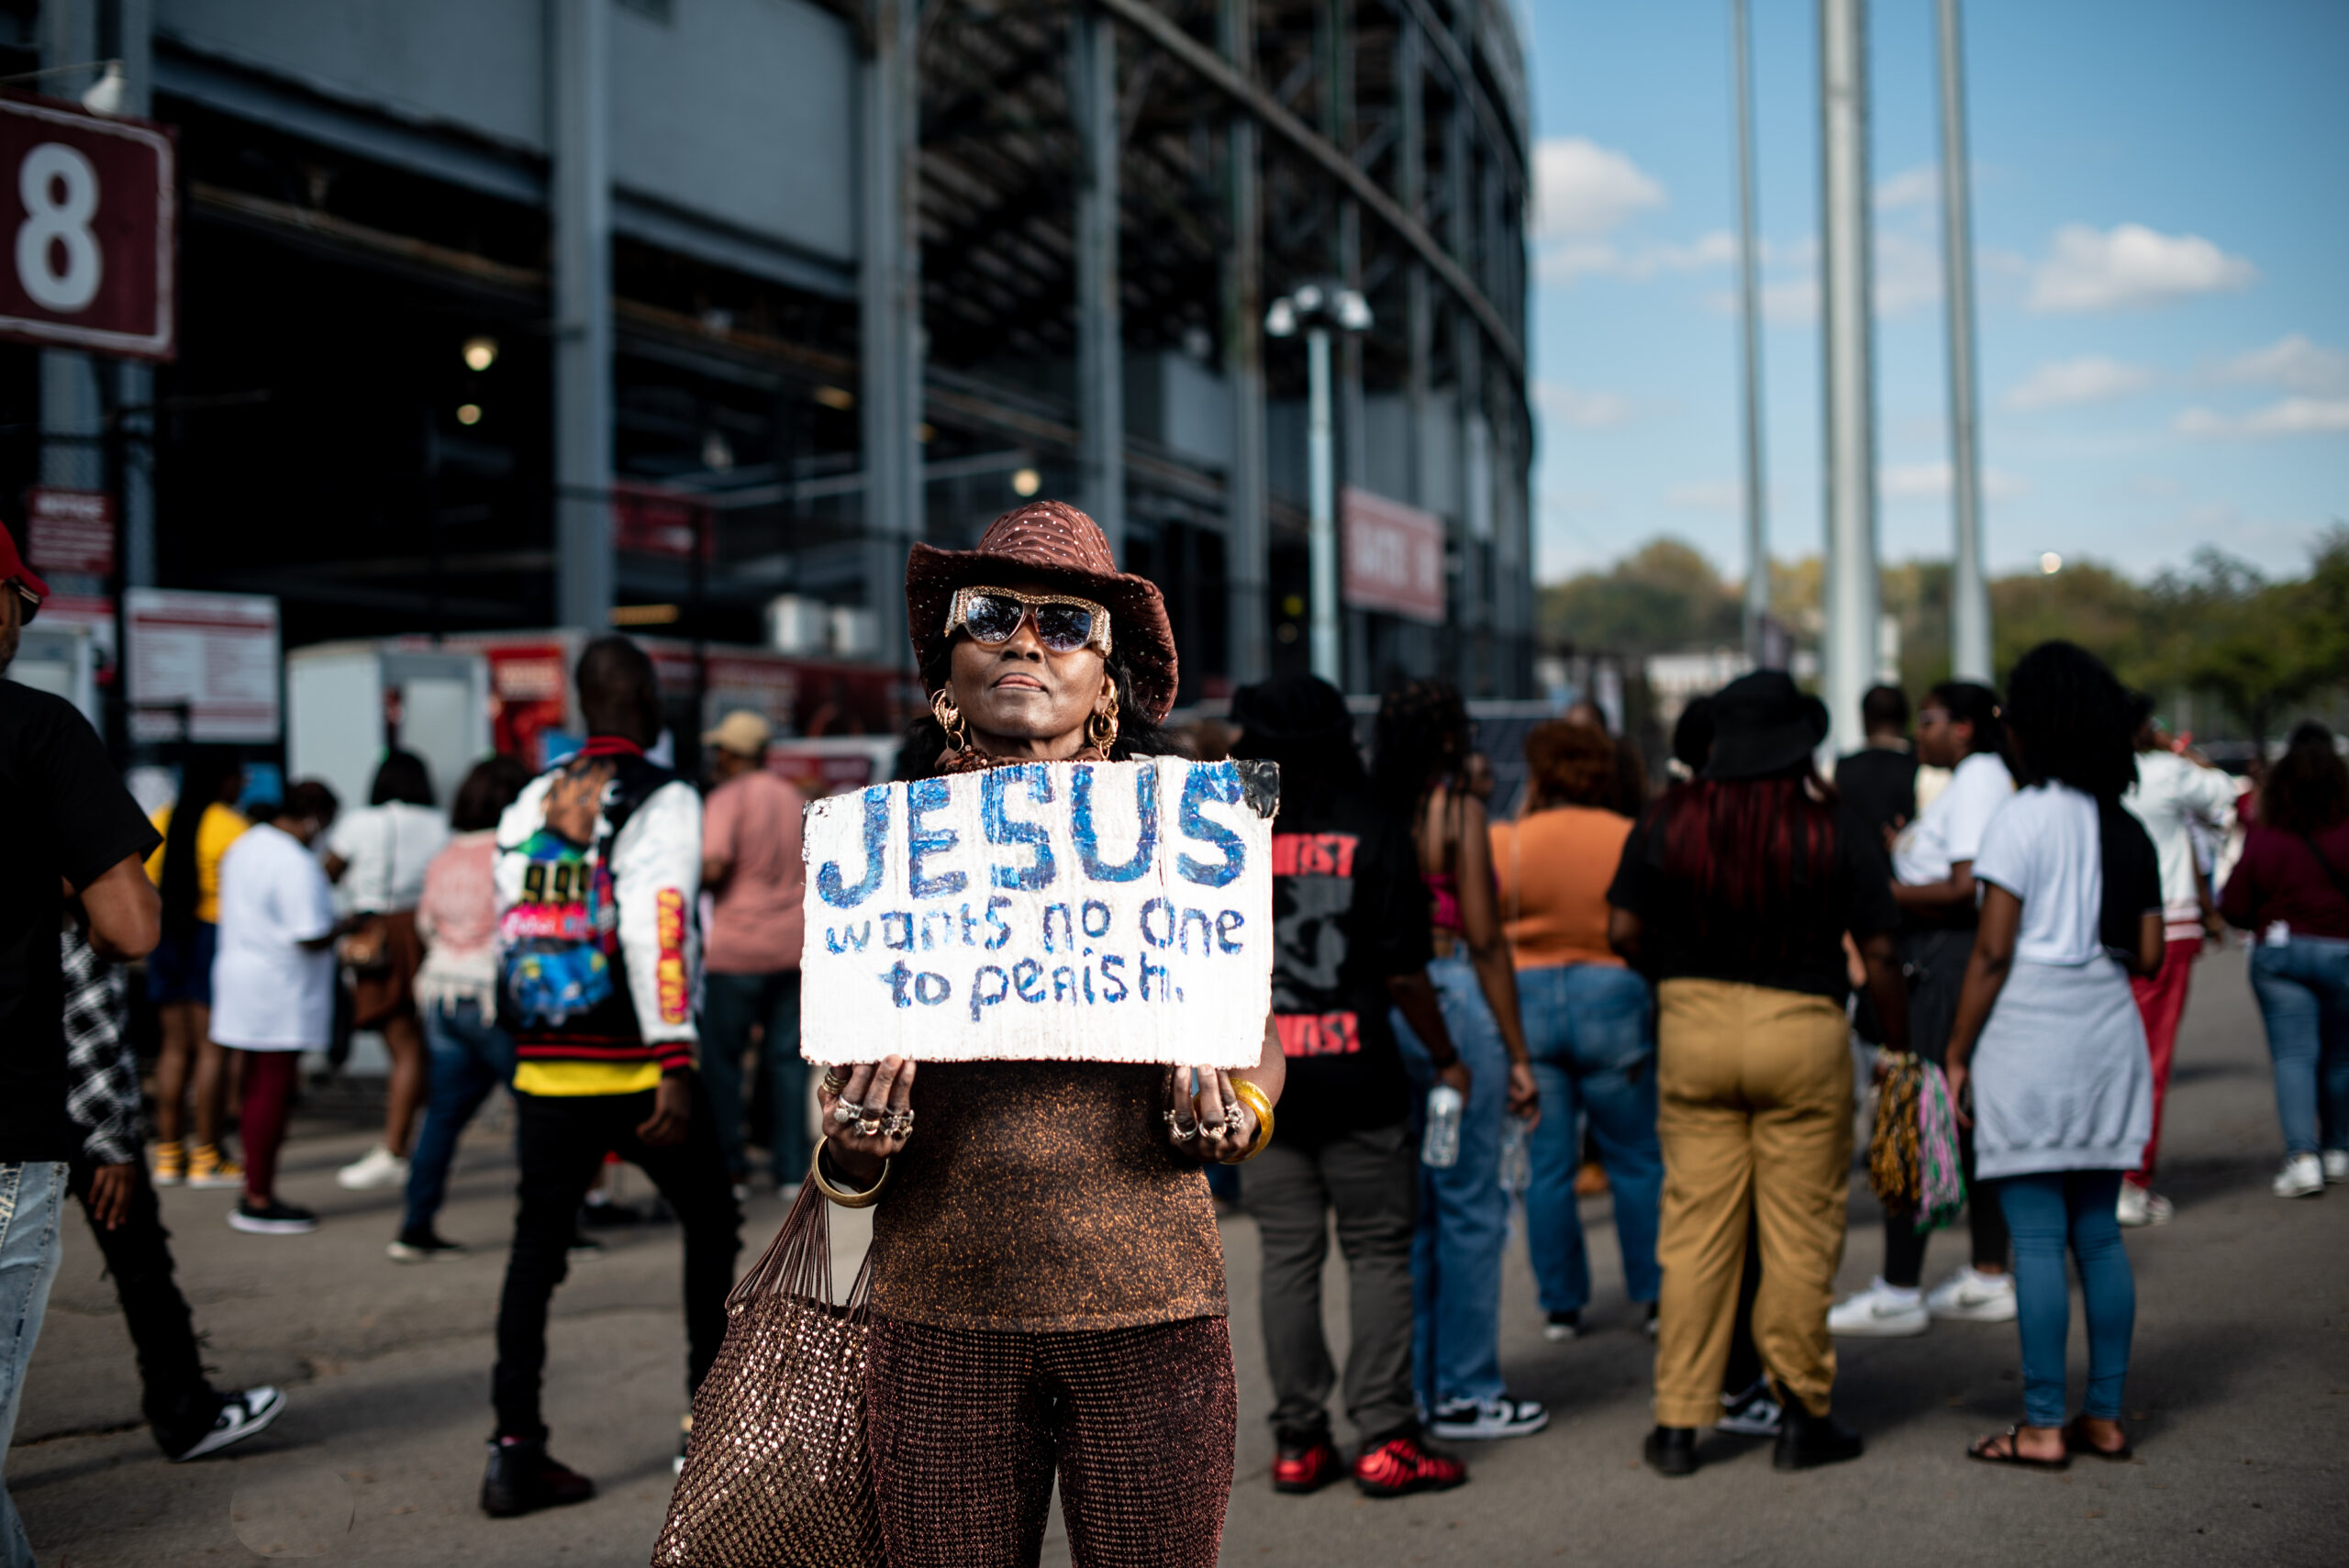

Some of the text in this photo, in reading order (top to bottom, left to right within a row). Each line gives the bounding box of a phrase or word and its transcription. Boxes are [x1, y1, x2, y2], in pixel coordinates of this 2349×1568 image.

[16, 141, 103, 313] 8
[817, 761, 1246, 908] JESUS
[825, 895, 1013, 954] wants
[1042, 898, 1111, 955] no
[878, 959, 952, 1008] to
